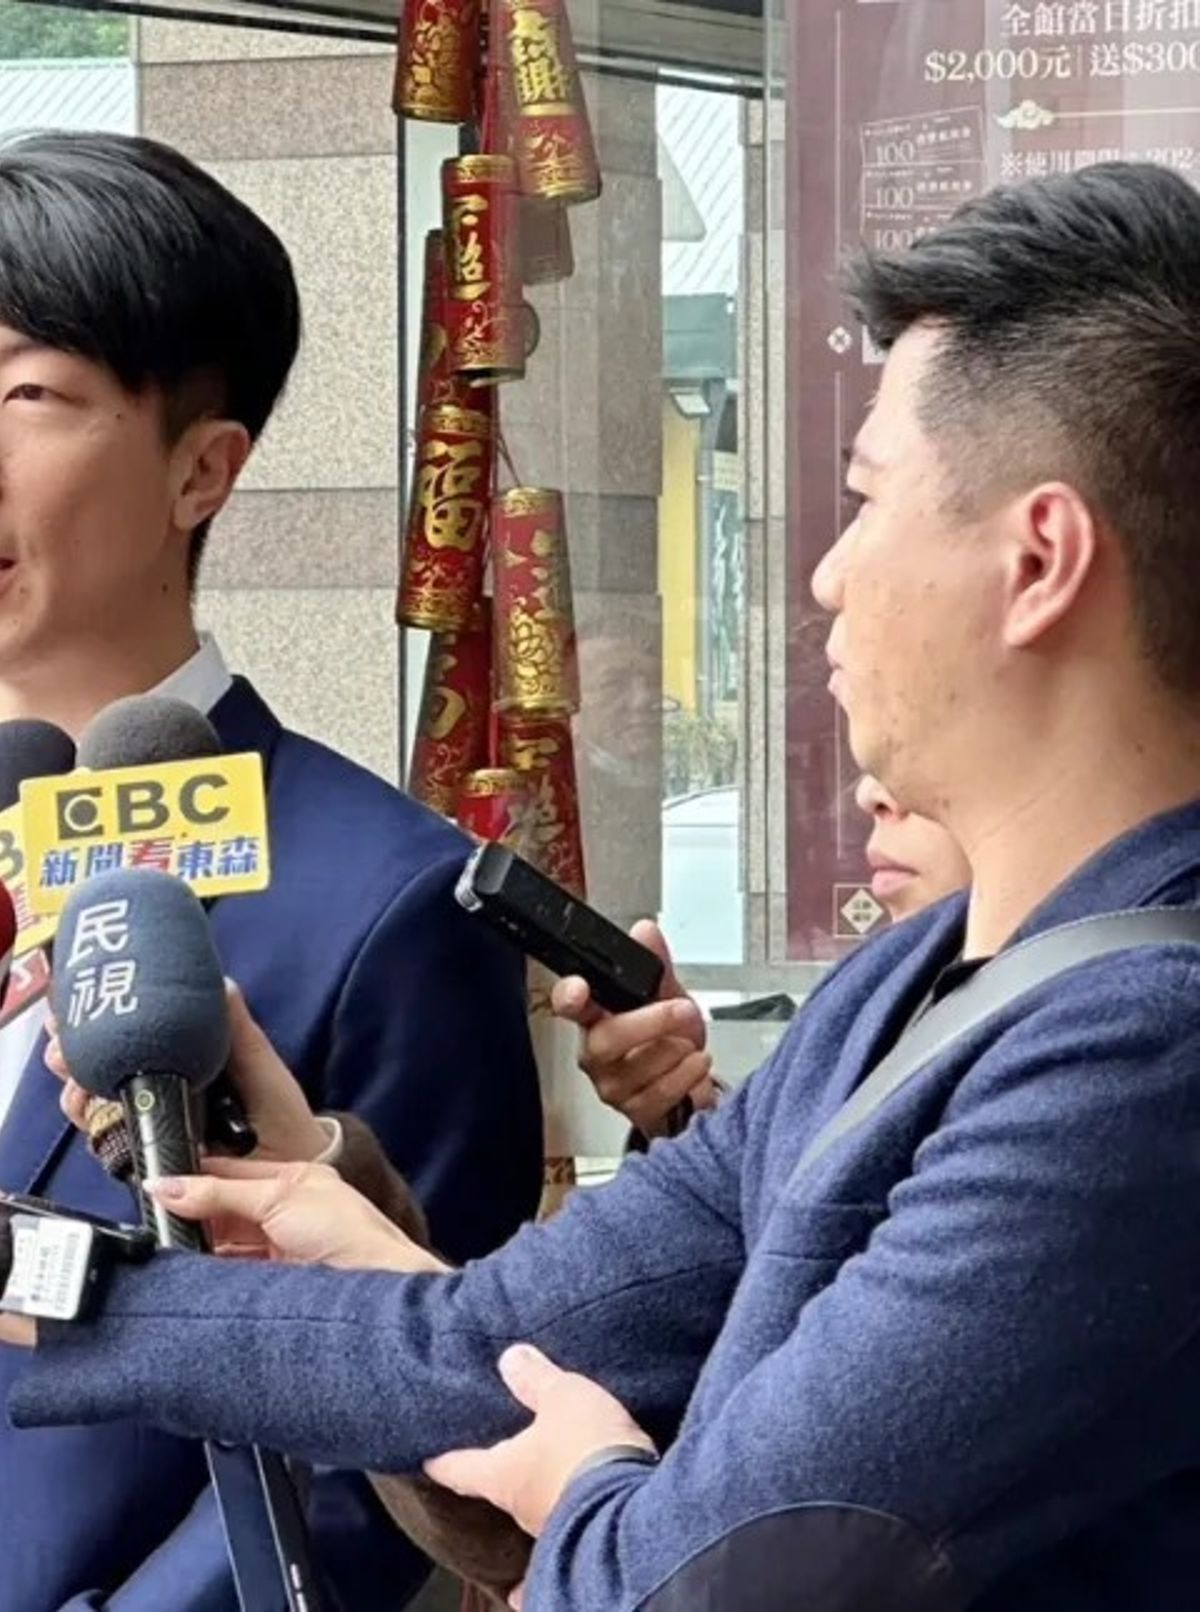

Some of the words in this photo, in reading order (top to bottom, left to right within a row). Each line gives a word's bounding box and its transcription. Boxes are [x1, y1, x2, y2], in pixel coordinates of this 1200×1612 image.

[56, 774, 231, 840] EBC
[39, 837, 260, 888] 新聞看東森
[66, 899, 138, 1027] 民視
